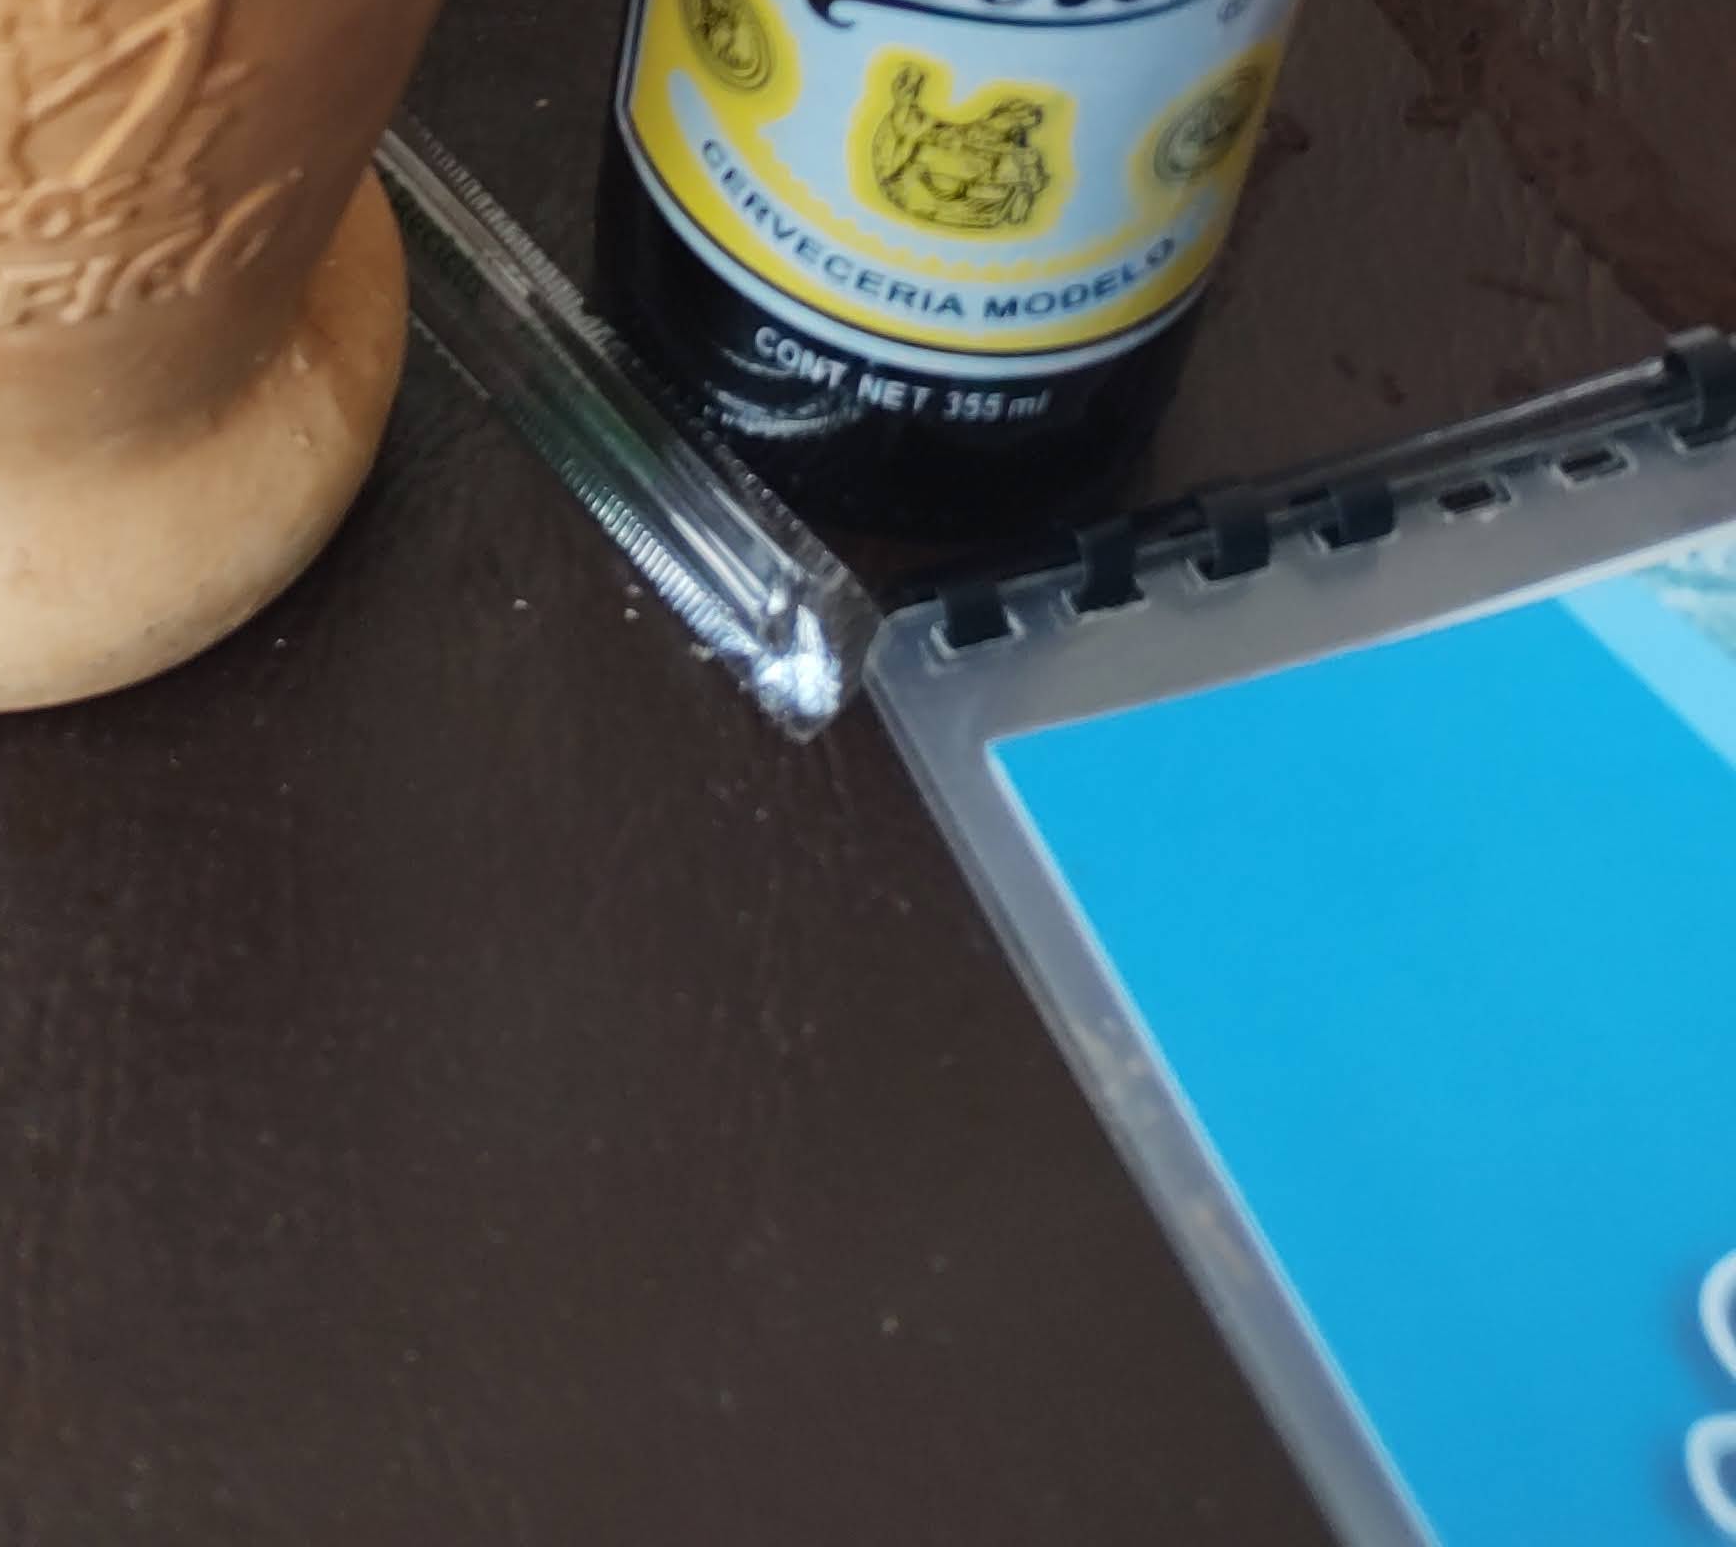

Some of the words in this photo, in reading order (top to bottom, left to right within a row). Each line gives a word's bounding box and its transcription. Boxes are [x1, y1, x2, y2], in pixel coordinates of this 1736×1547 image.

[700, 137, 965, 318] CERVECERIA
[981, 235, 1178, 319] MODELO
[753, 325, 850, 391] CONT
[856, 369, 937, 411] NET
